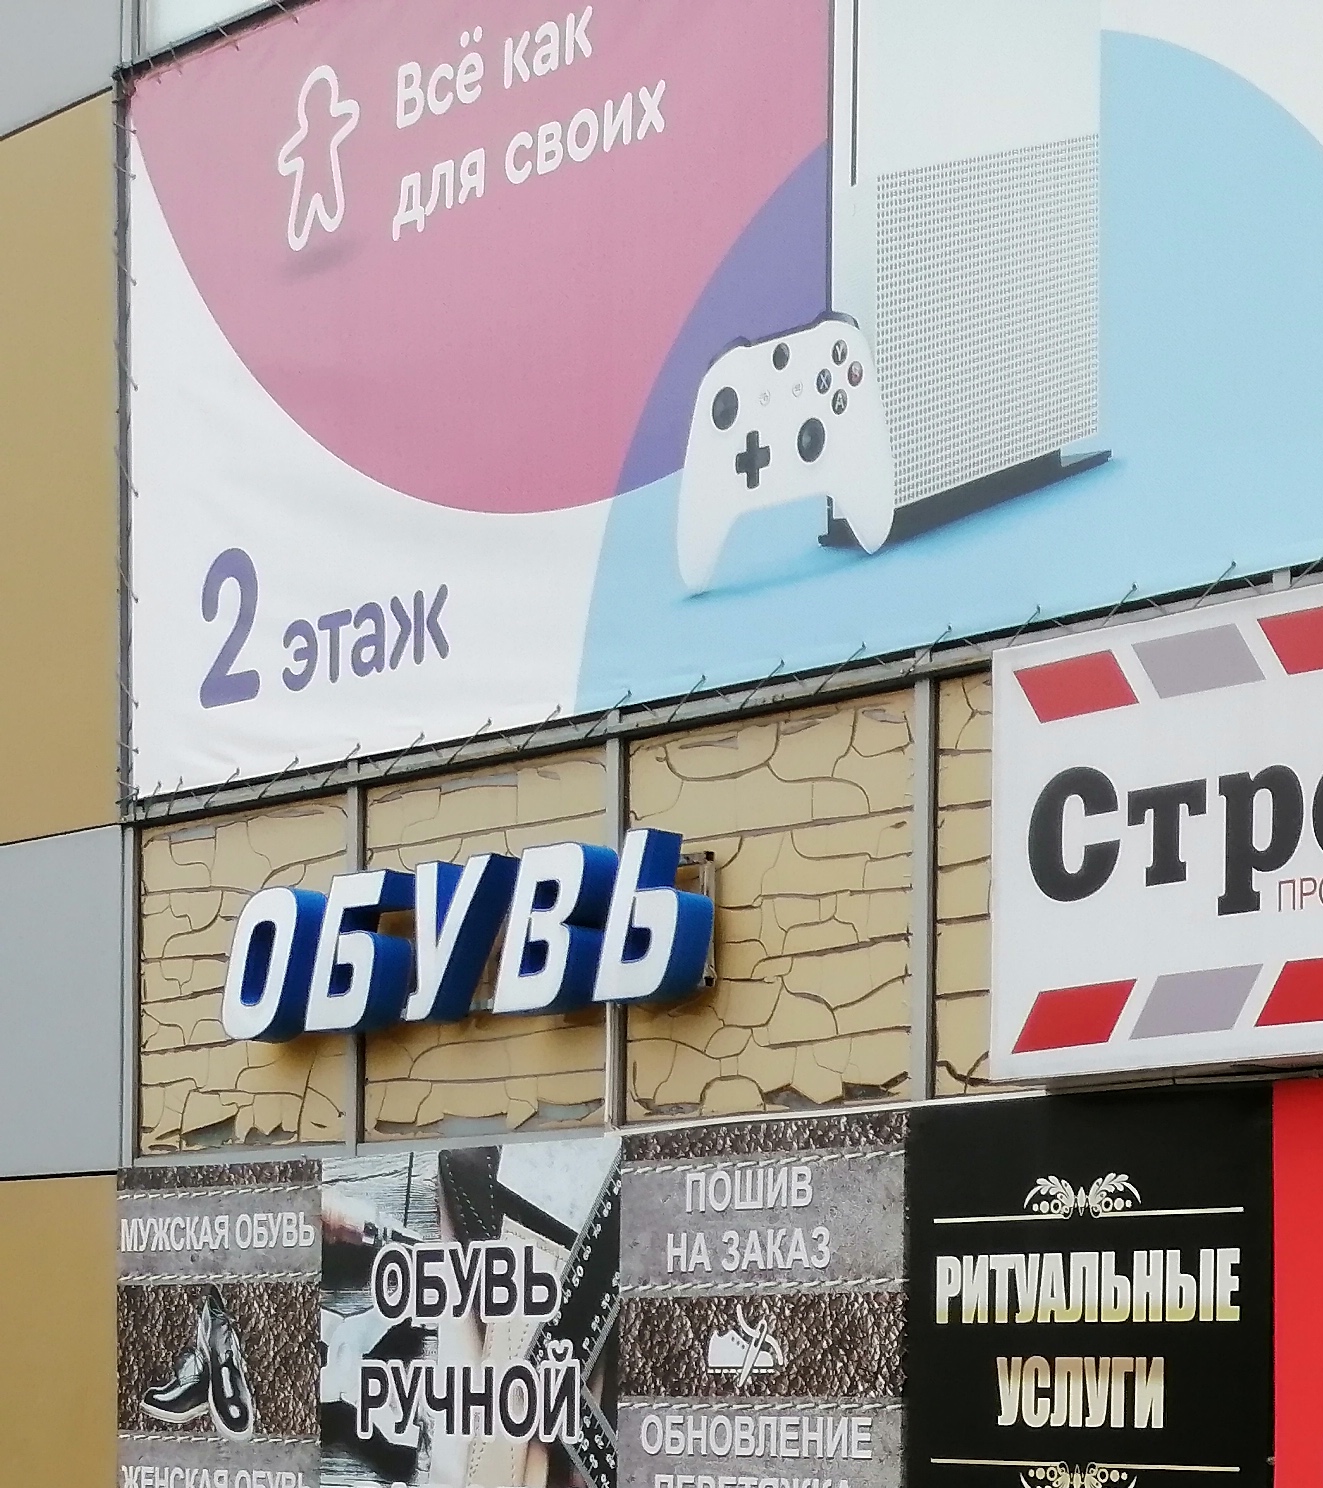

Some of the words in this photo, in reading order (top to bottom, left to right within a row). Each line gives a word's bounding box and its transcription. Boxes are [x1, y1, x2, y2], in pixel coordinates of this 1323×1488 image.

[396, 26, 485, 129] Всё
[503, 6, 593, 89] как
[392, 147, 486, 241] для
[505, 80, 667, 186] своих
[200, 547, 260, 709] 2
[281, 583, 450, 693] этаж
[221, 827, 712, 1043] ОБУВЬ
[684, 1166, 814, 1213] ПОШИВ
[121, 1218, 230, 1252] МУЖСКАЯ
[234, 1214, 315, 1250] ОБУВЬ
[666, 1234, 711, 1273] НА
[720, 1226, 831, 1271] ЗАКАЗ
[372, 1241, 561, 1318] ОБУВЬ
[935, 1248, 1241, 1325] РИТУАЛЬНЫЕ
[361, 1340, 580, 1440] РУЧНОЙ
[997, 1355, 1166, 1429] УСЛУГИ
[641, 1415, 874, 1461] ОБНОВЛЕНИЕ
